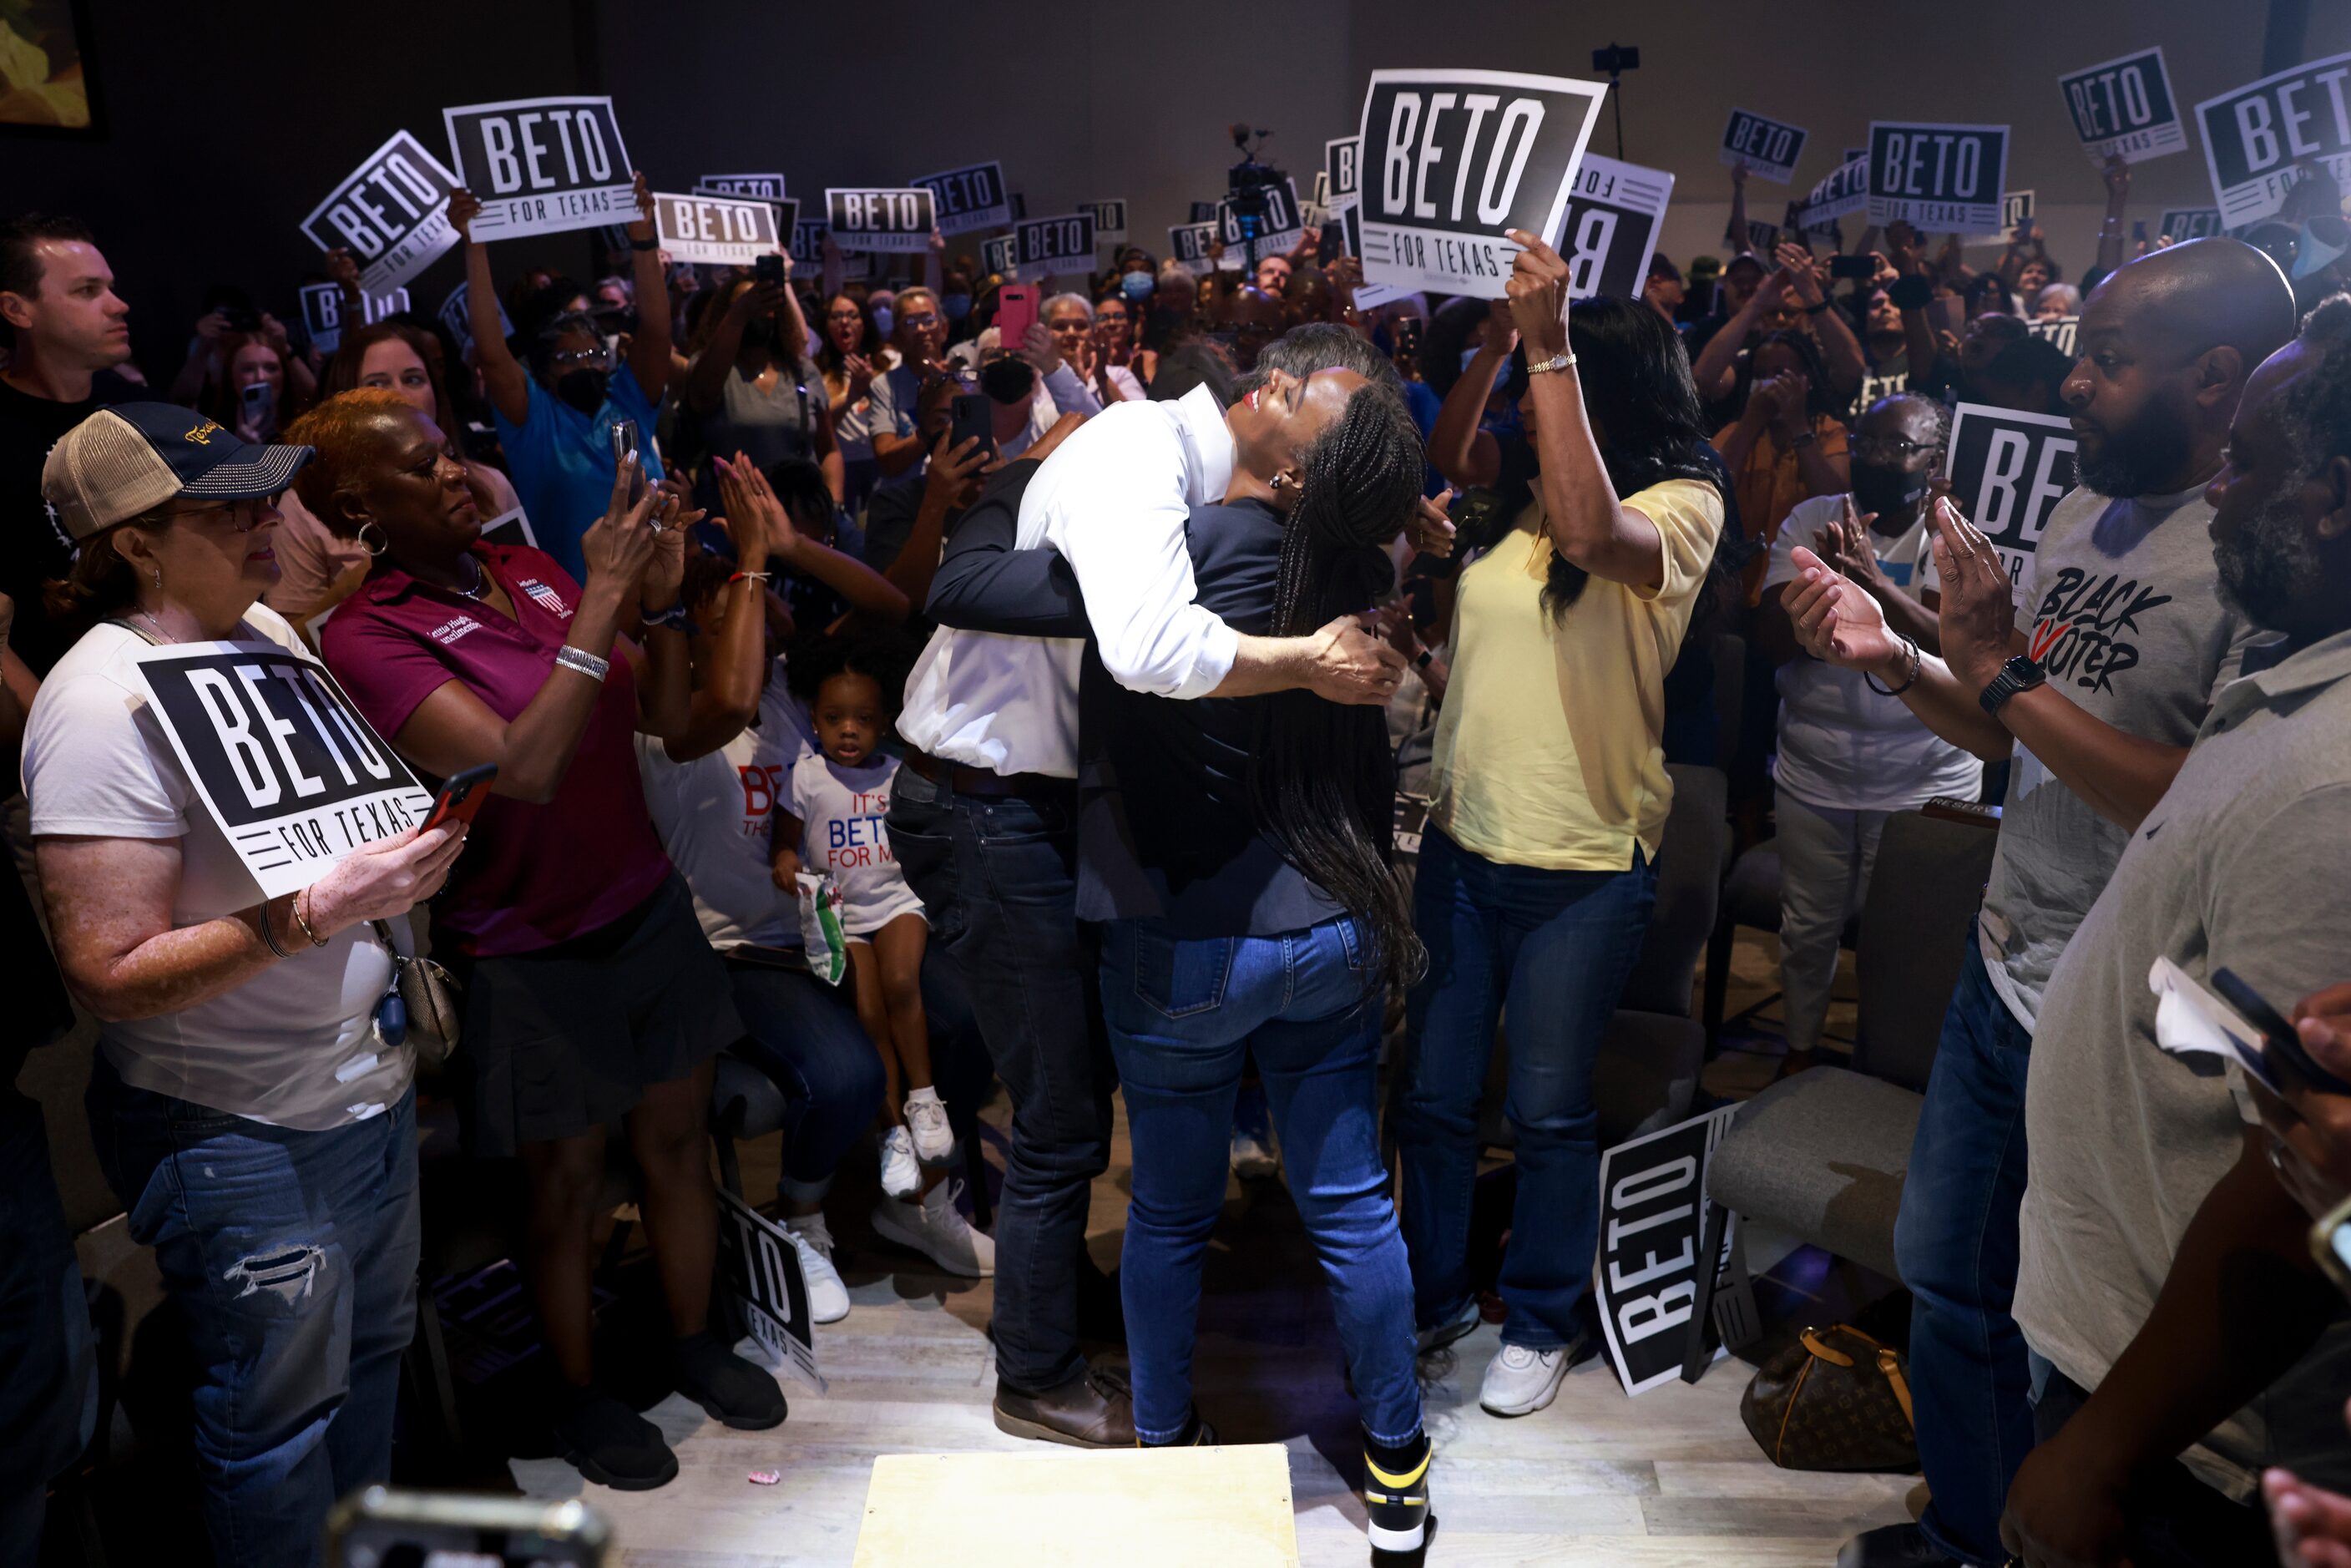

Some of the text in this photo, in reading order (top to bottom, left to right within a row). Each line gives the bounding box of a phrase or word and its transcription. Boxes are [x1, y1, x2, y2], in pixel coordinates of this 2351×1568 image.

[2070, 65, 2151, 138] BETO
[480, 109, 612, 194] BETO
[1383, 92, 1545, 225] BETO
[1732, 116, 1793, 163] BETO
[1883, 133, 1982, 199] BETO
[326, 152, 440, 260] BETO
[509, 191, 609, 224] FOR TEXAS
[843, 193, 919, 231] BETO
[925, 170, 993, 217] BETO
[1921, 205, 1966, 223] TEXAS
[673, 200, 759, 241] BETO
[1096, 204, 1117, 230] TO
[2172, 212, 2222, 243] BET
[384, 245, 416, 273] FOR
[796, 225, 822, 260] BE
[991, 239, 1016, 271] BE
[1028, 219, 1083, 261] BETO
[1181, 227, 1217, 260] BET
[1394, 233, 1499, 277] FOR TEXAS
[1973, 428, 2076, 543] BE
[2034, 567, 2172, 638] BLACK
[2030, 619, 2139, 696] VOTER
[185, 664, 392, 809] BETO
[853, 794, 886, 814] IT'S
[278, 797, 414, 861] FOR TEXAS
[829, 817, 882, 848] BET
[828, 845, 894, 868] FOR M
[731, 1210, 791, 1324] TO
[1607, 1155, 1697, 1345] BETO
